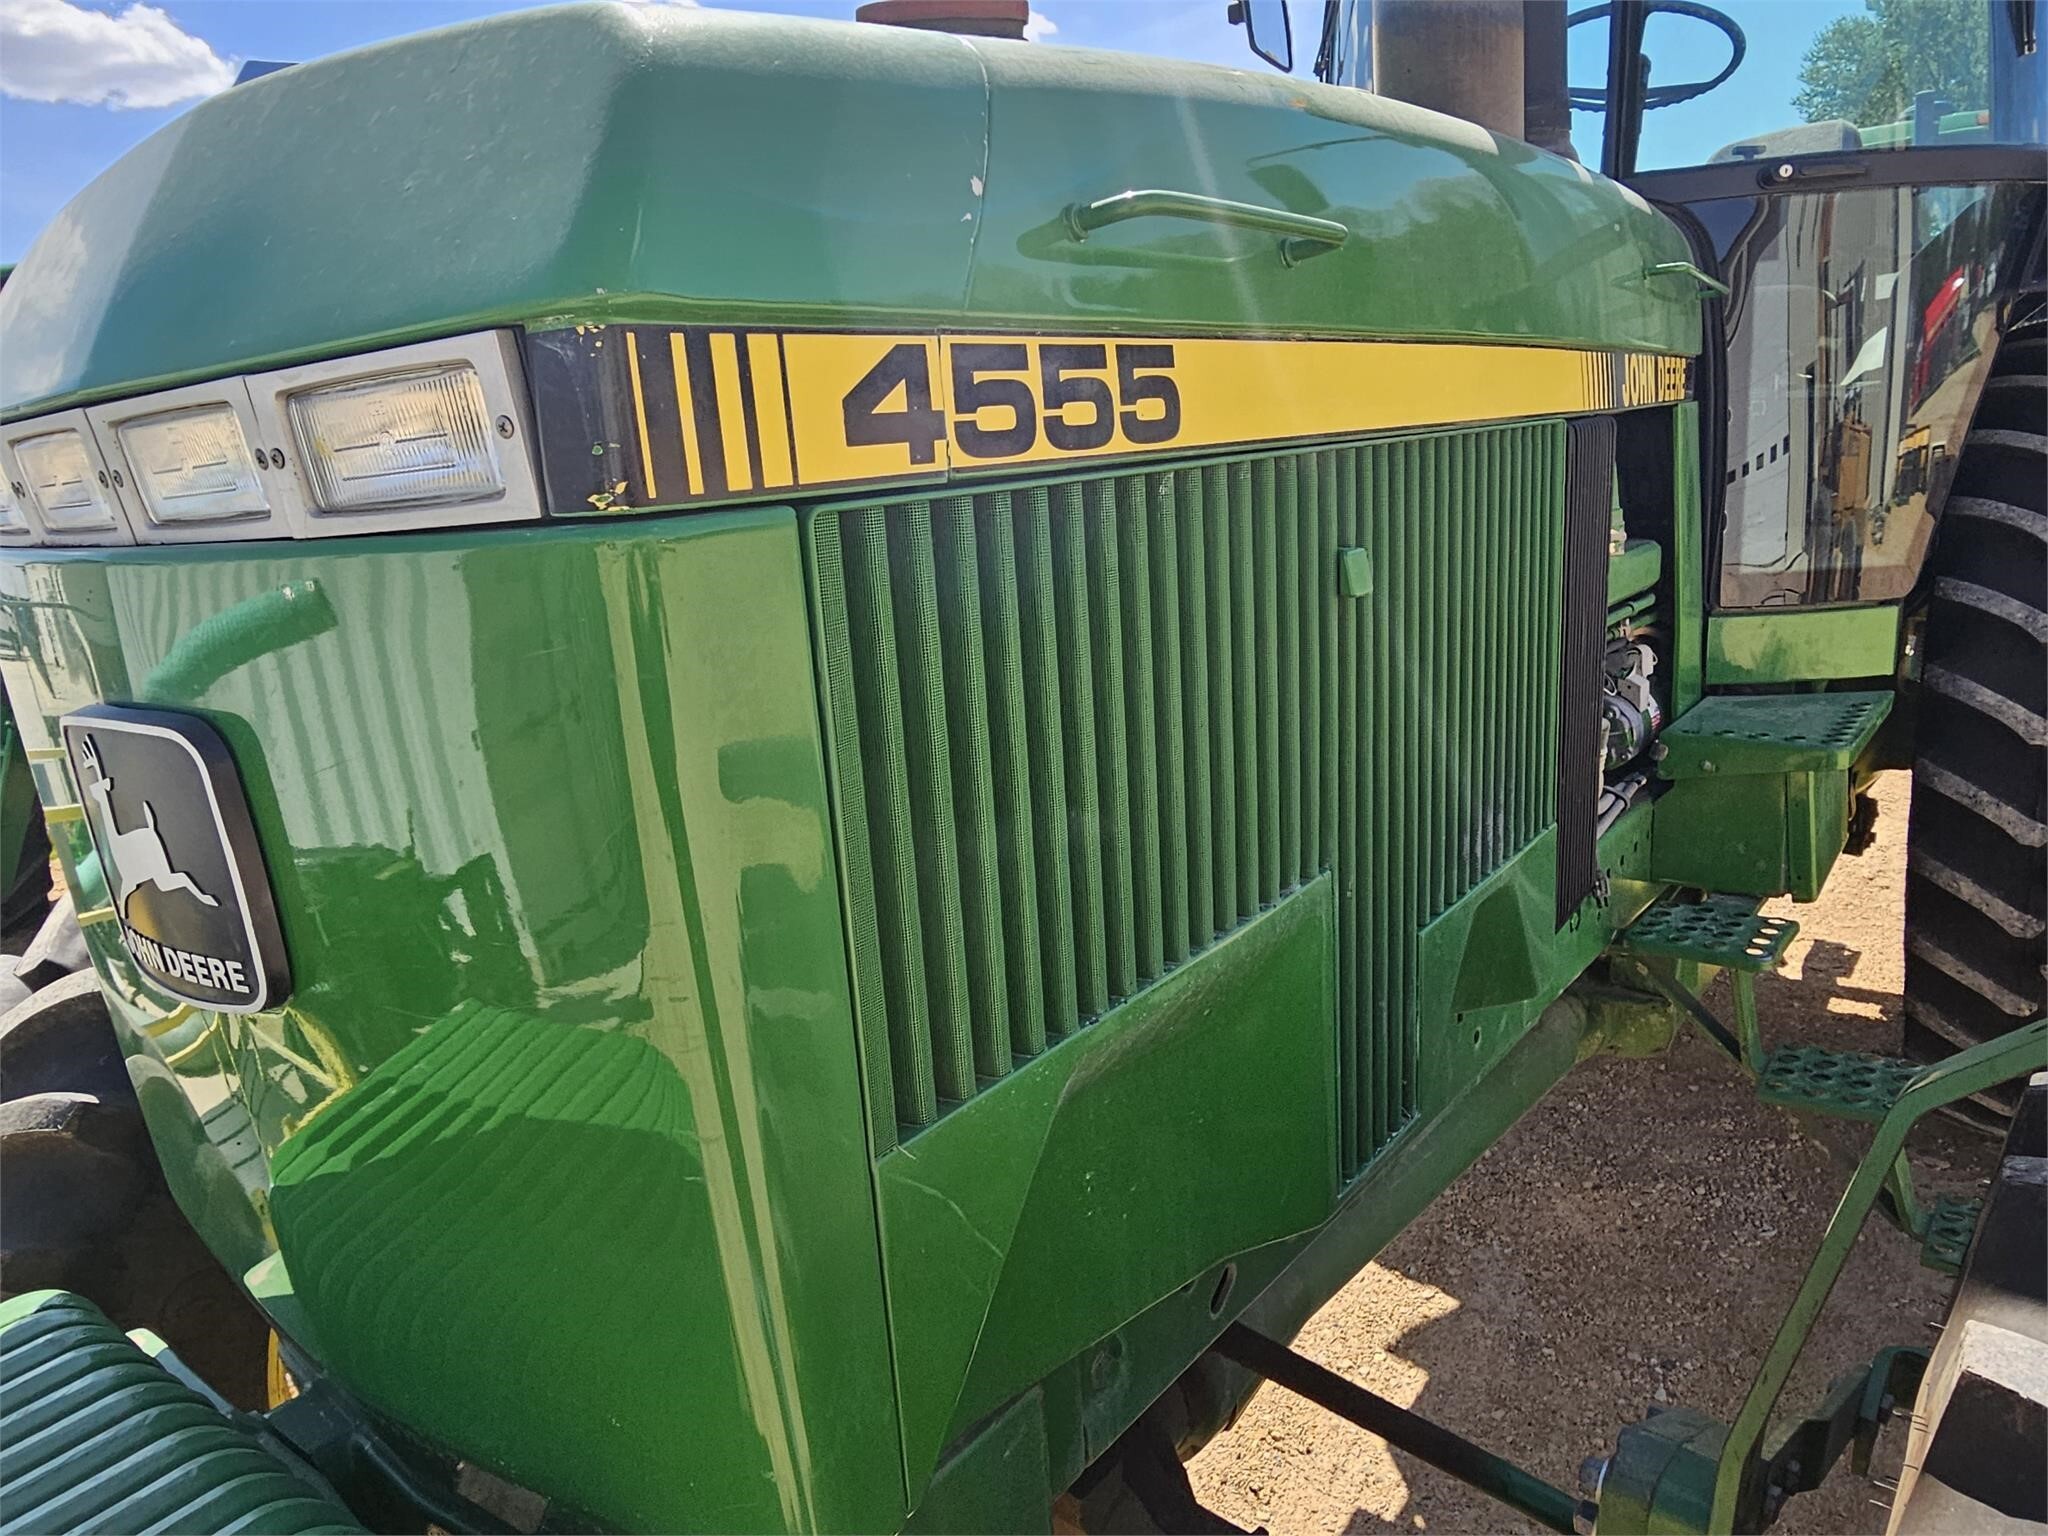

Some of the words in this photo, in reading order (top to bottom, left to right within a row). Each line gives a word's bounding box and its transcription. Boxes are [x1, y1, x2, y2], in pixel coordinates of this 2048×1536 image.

[842, 343, 1181, 466] 4555
[1622, 353, 1655, 407] JOHN
[1657, 355, 1686, 402] DEERE
[124, 925, 165, 973] JOHN
[163, 946, 250, 994] DEERE
